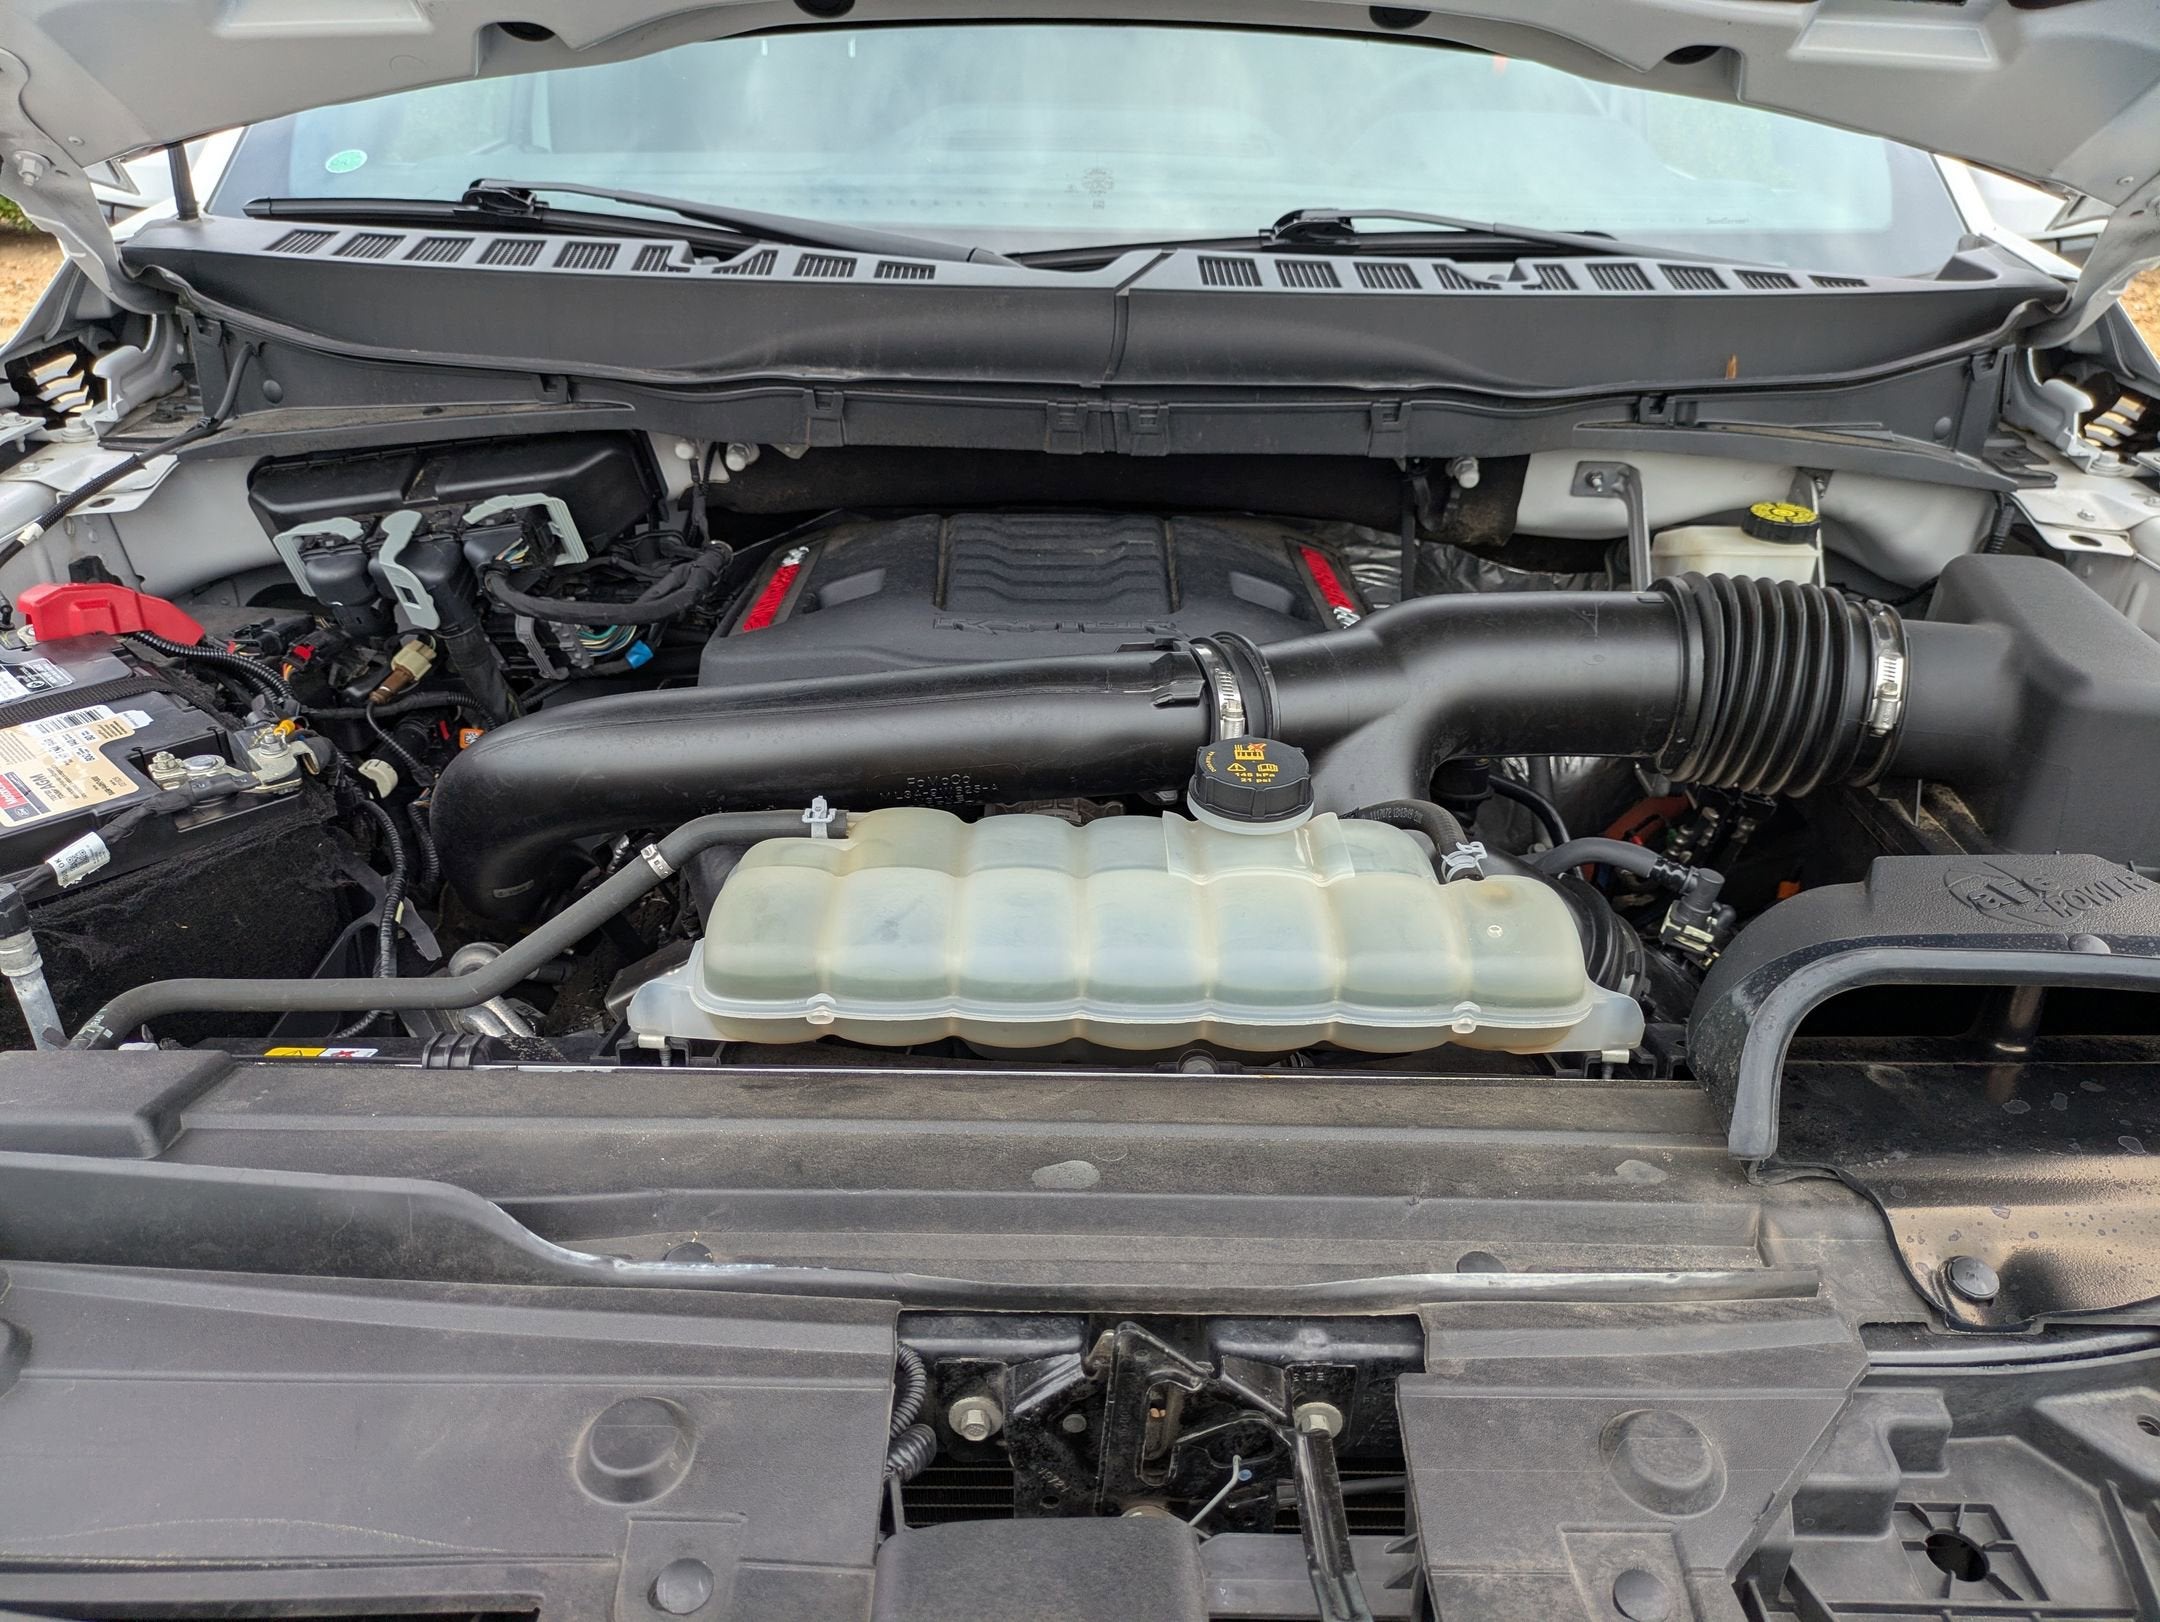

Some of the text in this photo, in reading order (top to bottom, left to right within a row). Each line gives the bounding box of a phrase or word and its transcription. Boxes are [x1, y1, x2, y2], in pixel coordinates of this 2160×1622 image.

[30, 773, 55, 790] AGM
[907, 773, 971, 788] FoMoCo
[2043, 875, 2149, 918] POWER
